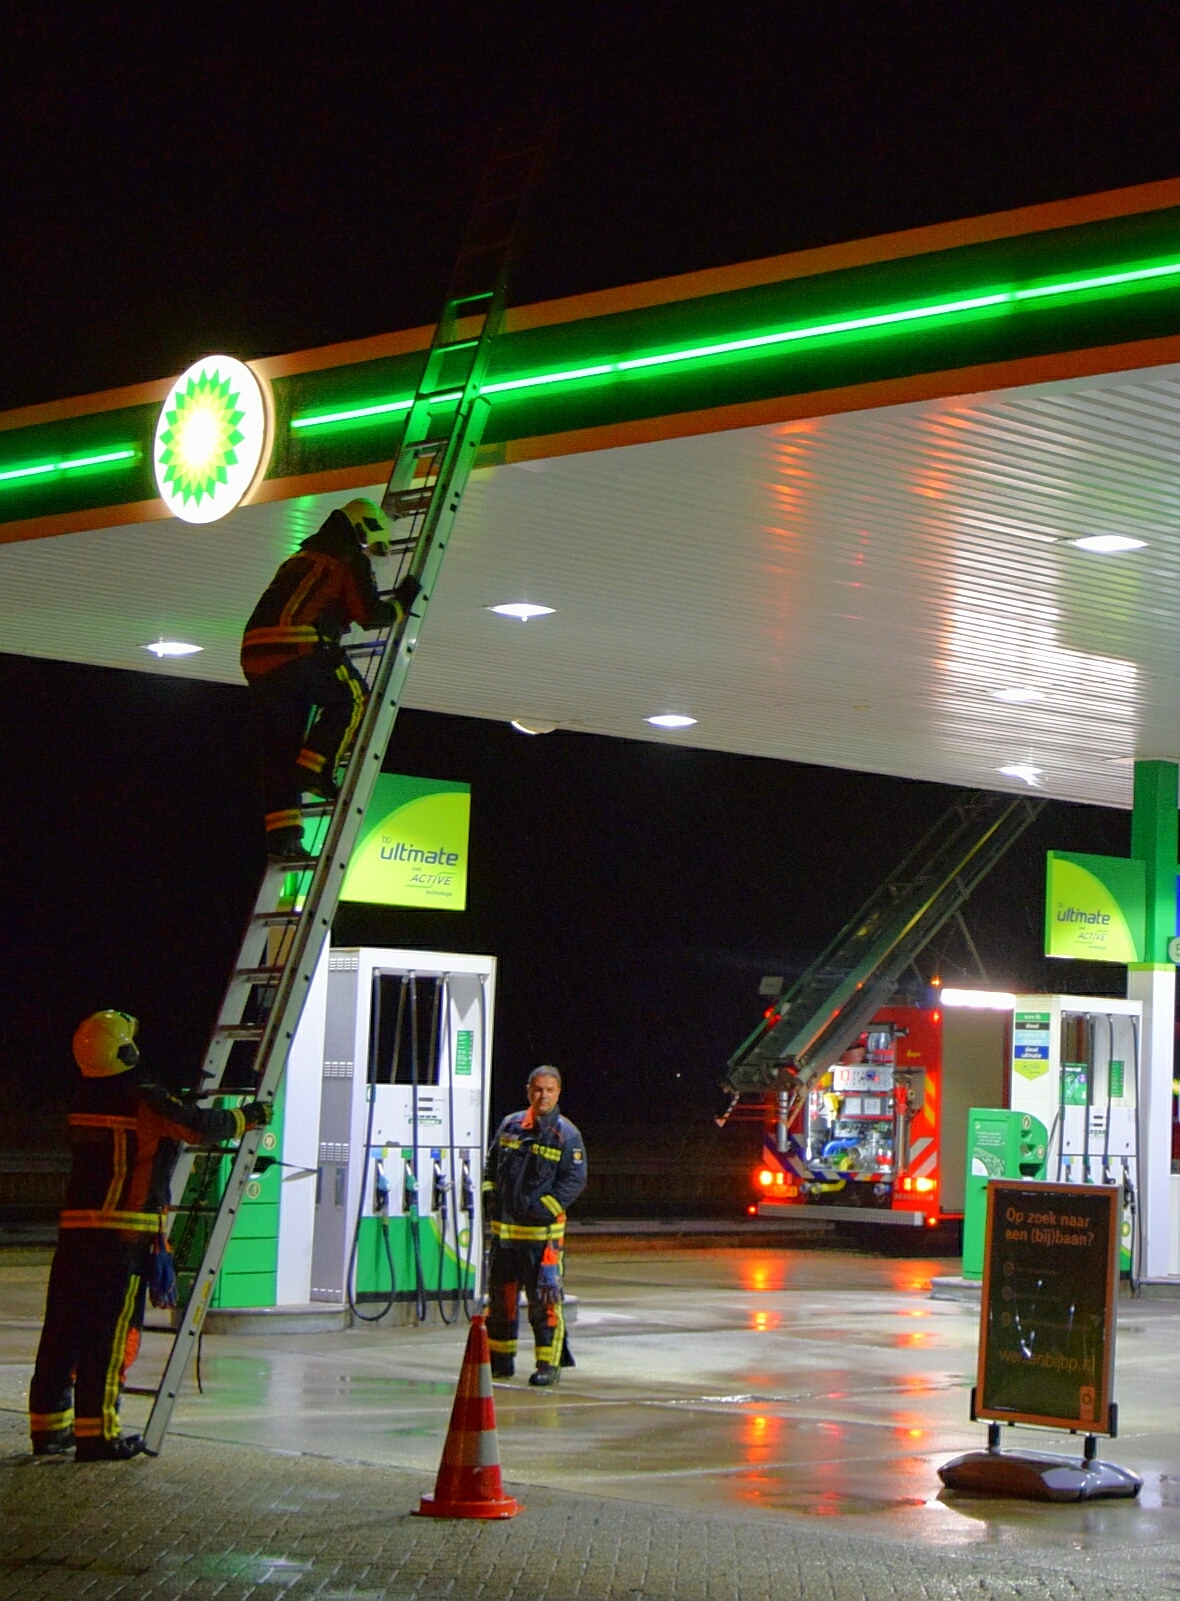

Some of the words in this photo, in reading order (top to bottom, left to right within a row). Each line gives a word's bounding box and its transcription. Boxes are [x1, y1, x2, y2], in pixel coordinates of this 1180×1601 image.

[380, 842, 459, 867] ultimate
[410, 873, 453, 886] ACTIVE
[1057, 907, 1111, 926] ultimate
[1078, 932, 1107, 941] ACTIVE
[1006, 1207, 1024, 1226] Op
[1027, 1211, 1057, 1225] zoek
[1060, 1214, 1091, 1228] naar
[1005, 1229, 1028, 1241] een
